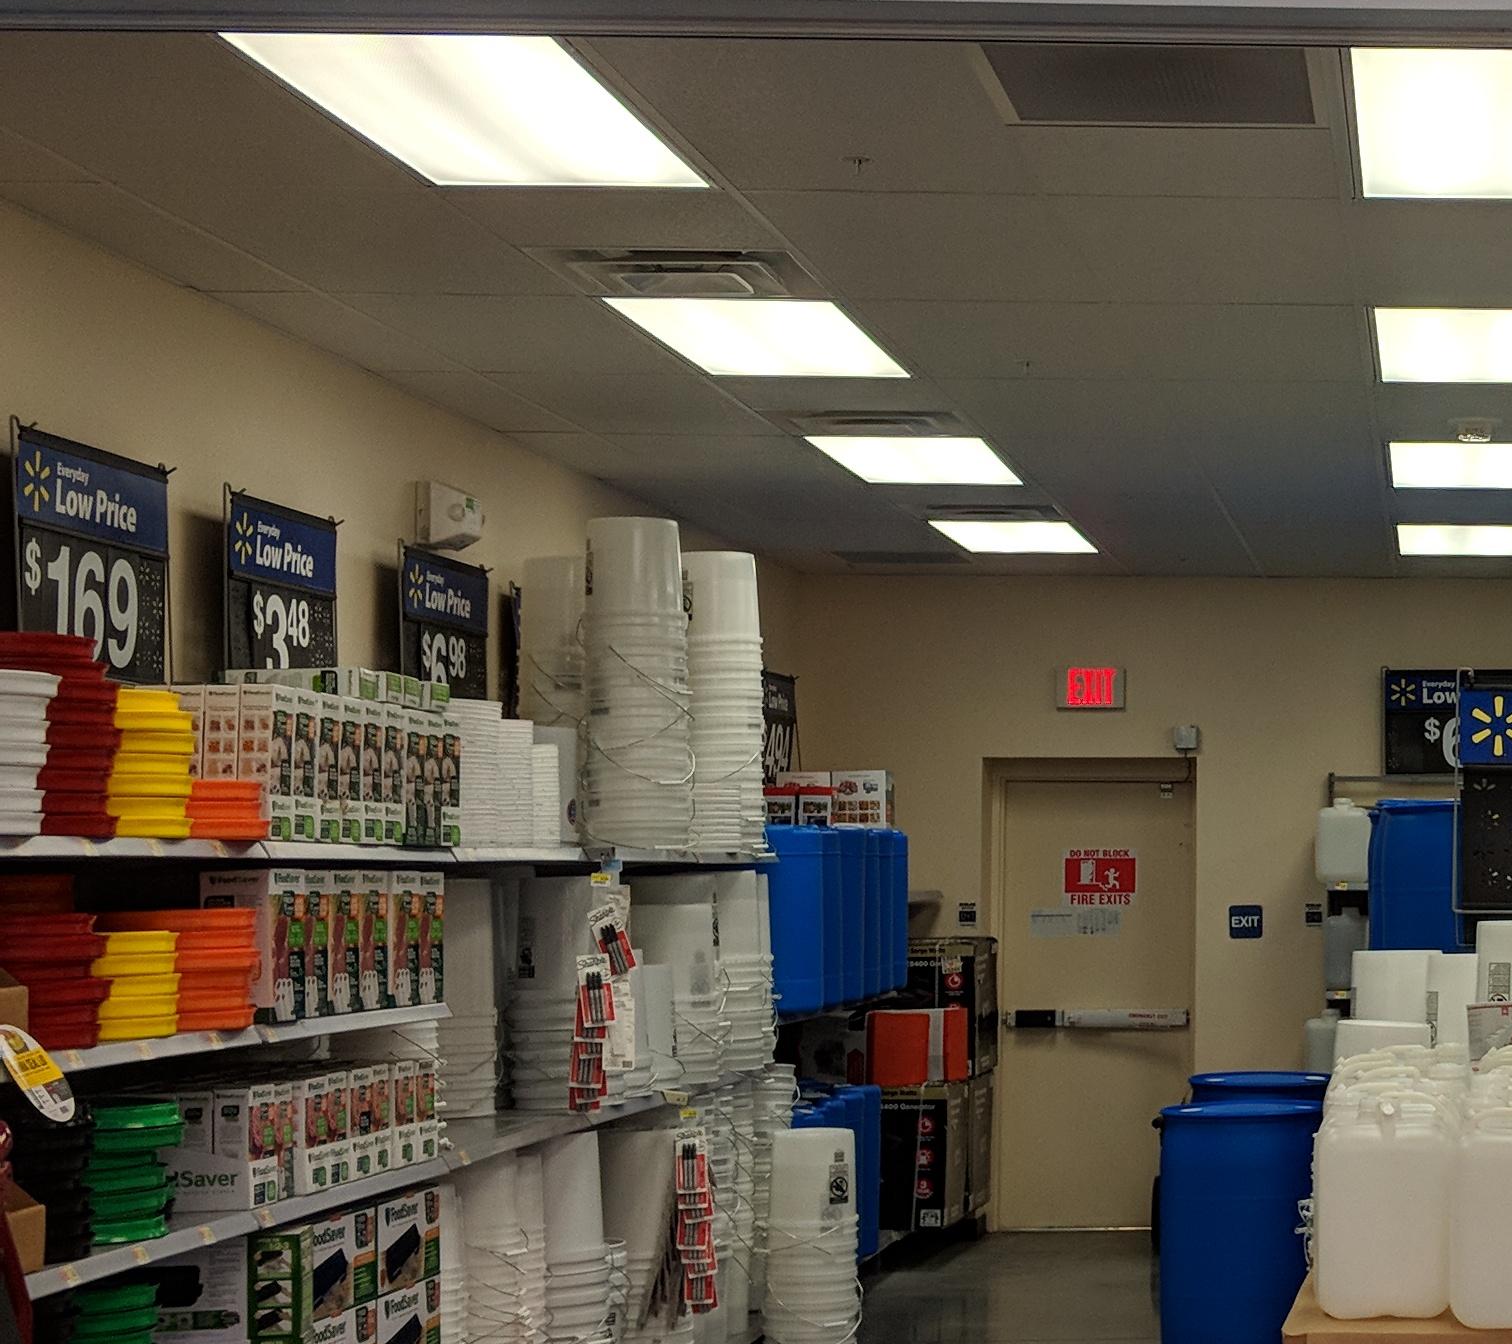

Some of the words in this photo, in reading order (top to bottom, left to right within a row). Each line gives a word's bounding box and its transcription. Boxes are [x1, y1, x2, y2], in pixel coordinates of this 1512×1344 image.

[56, 462, 89, 487] Everyday
[55, 478, 93, 521] Low
[95, 492, 137, 533] Price
[256, 535, 282, 568] Low
[284, 545, 314, 579] Price
[425, 580, 446, 611] Low
[447, 589, 471, 620] Price
[1067, 667, 1116, 705] EXIT
[1422, 687, 1460, 705] Low
[1070, 849, 1082, 858] DO
[1084, 849, 1100, 858] NOT
[1103, 849, 1130, 858] BLOCK
[1070, 894, 1095, 905] FIRE
[1099, 894, 1131, 905] EXITS
[1231, 916, 1260, 928] EXIT
[390, 1202, 419, 1222] FoodSaver
[390, 1292, 419, 1314] FoodSaver
